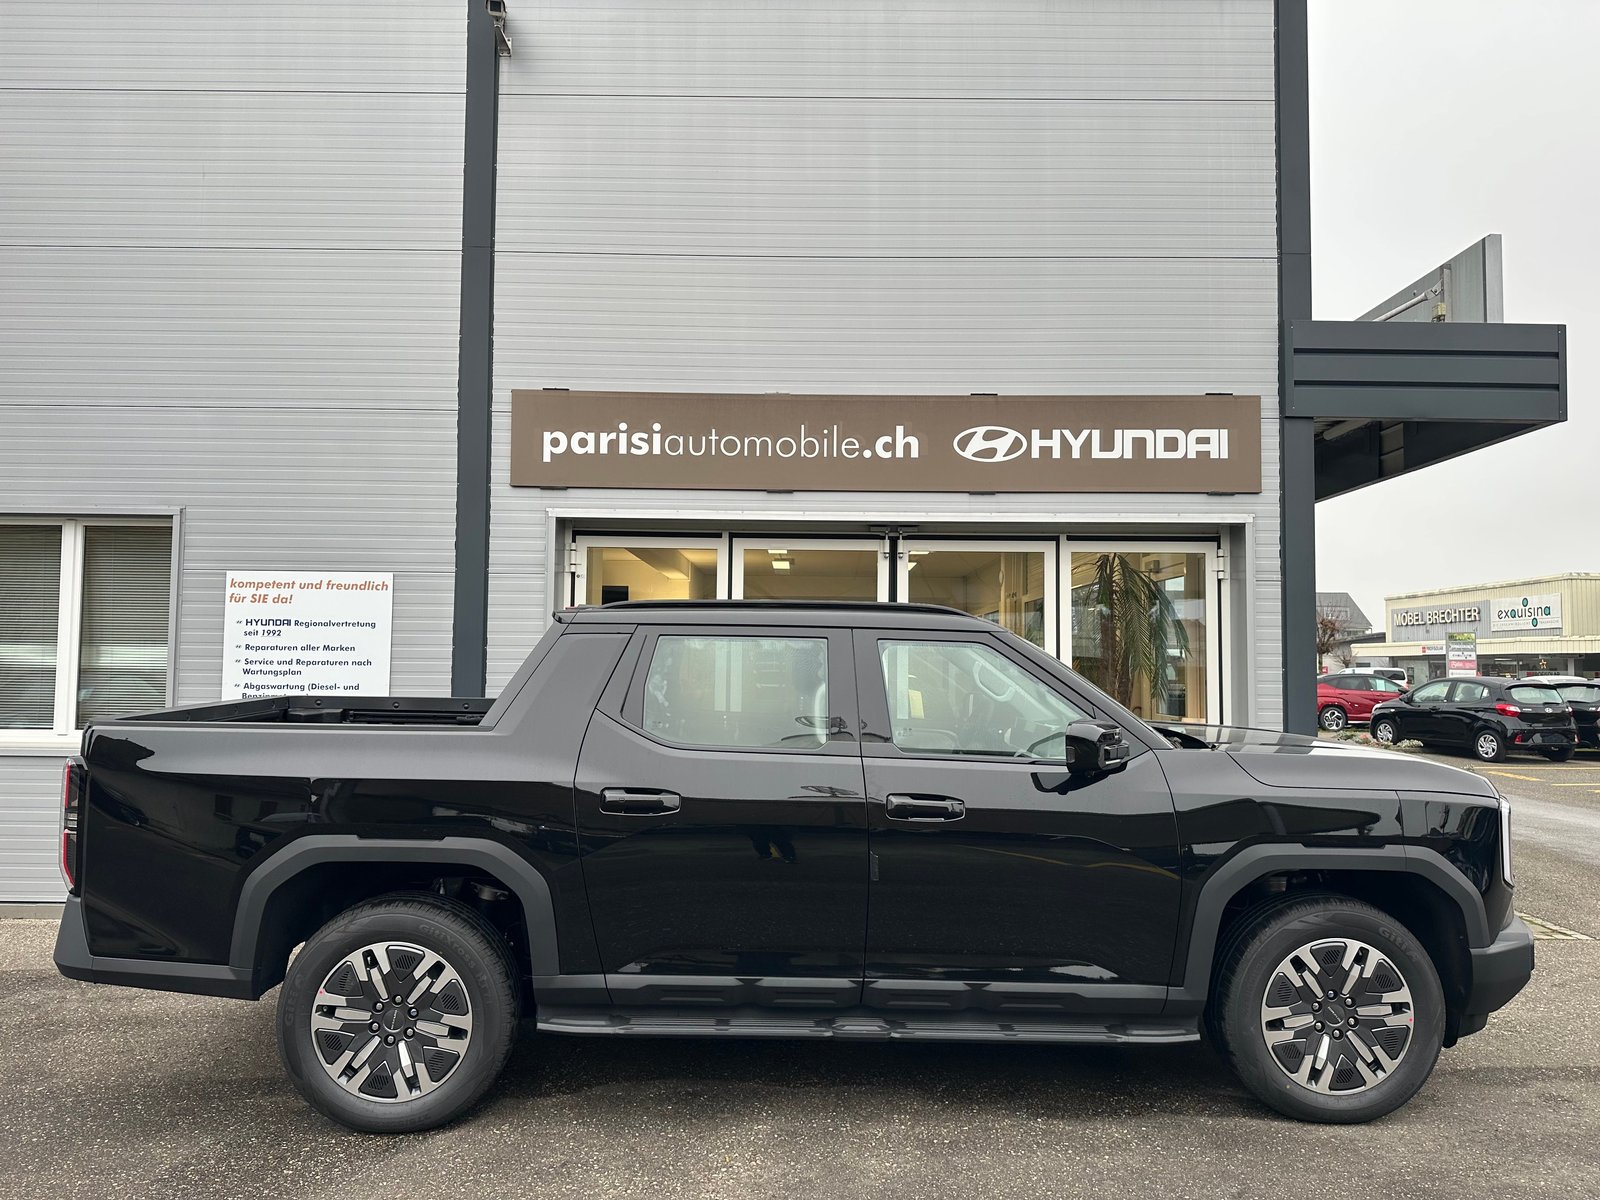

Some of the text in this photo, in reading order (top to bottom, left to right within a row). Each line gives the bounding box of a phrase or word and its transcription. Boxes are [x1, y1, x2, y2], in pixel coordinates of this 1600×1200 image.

[543, 423, 918, 462] parisiautomobile.ch
[1032, 429, 1228, 458] HYUNDAI
[229, 578, 389, 592] kompetent und freundlich
[229, 593, 294, 605] für SIE da!
[1426, 607, 1480, 624] BRECHTER
[245, 619, 377, 630] HYUNDAI Regionalvertretung
[243, 629, 259, 637] seit
[244, 644, 298, 653] Reparaturen
[300, 644, 321, 652] aller
[244, 658, 275, 666] Service
[295, 659, 349, 668] Reparaturen
[351, 659, 372, 667] nach
[242, 668, 302, 678] Wartungsplan
[243, 683, 360, 692] Abgaswartung (Diesel- und
